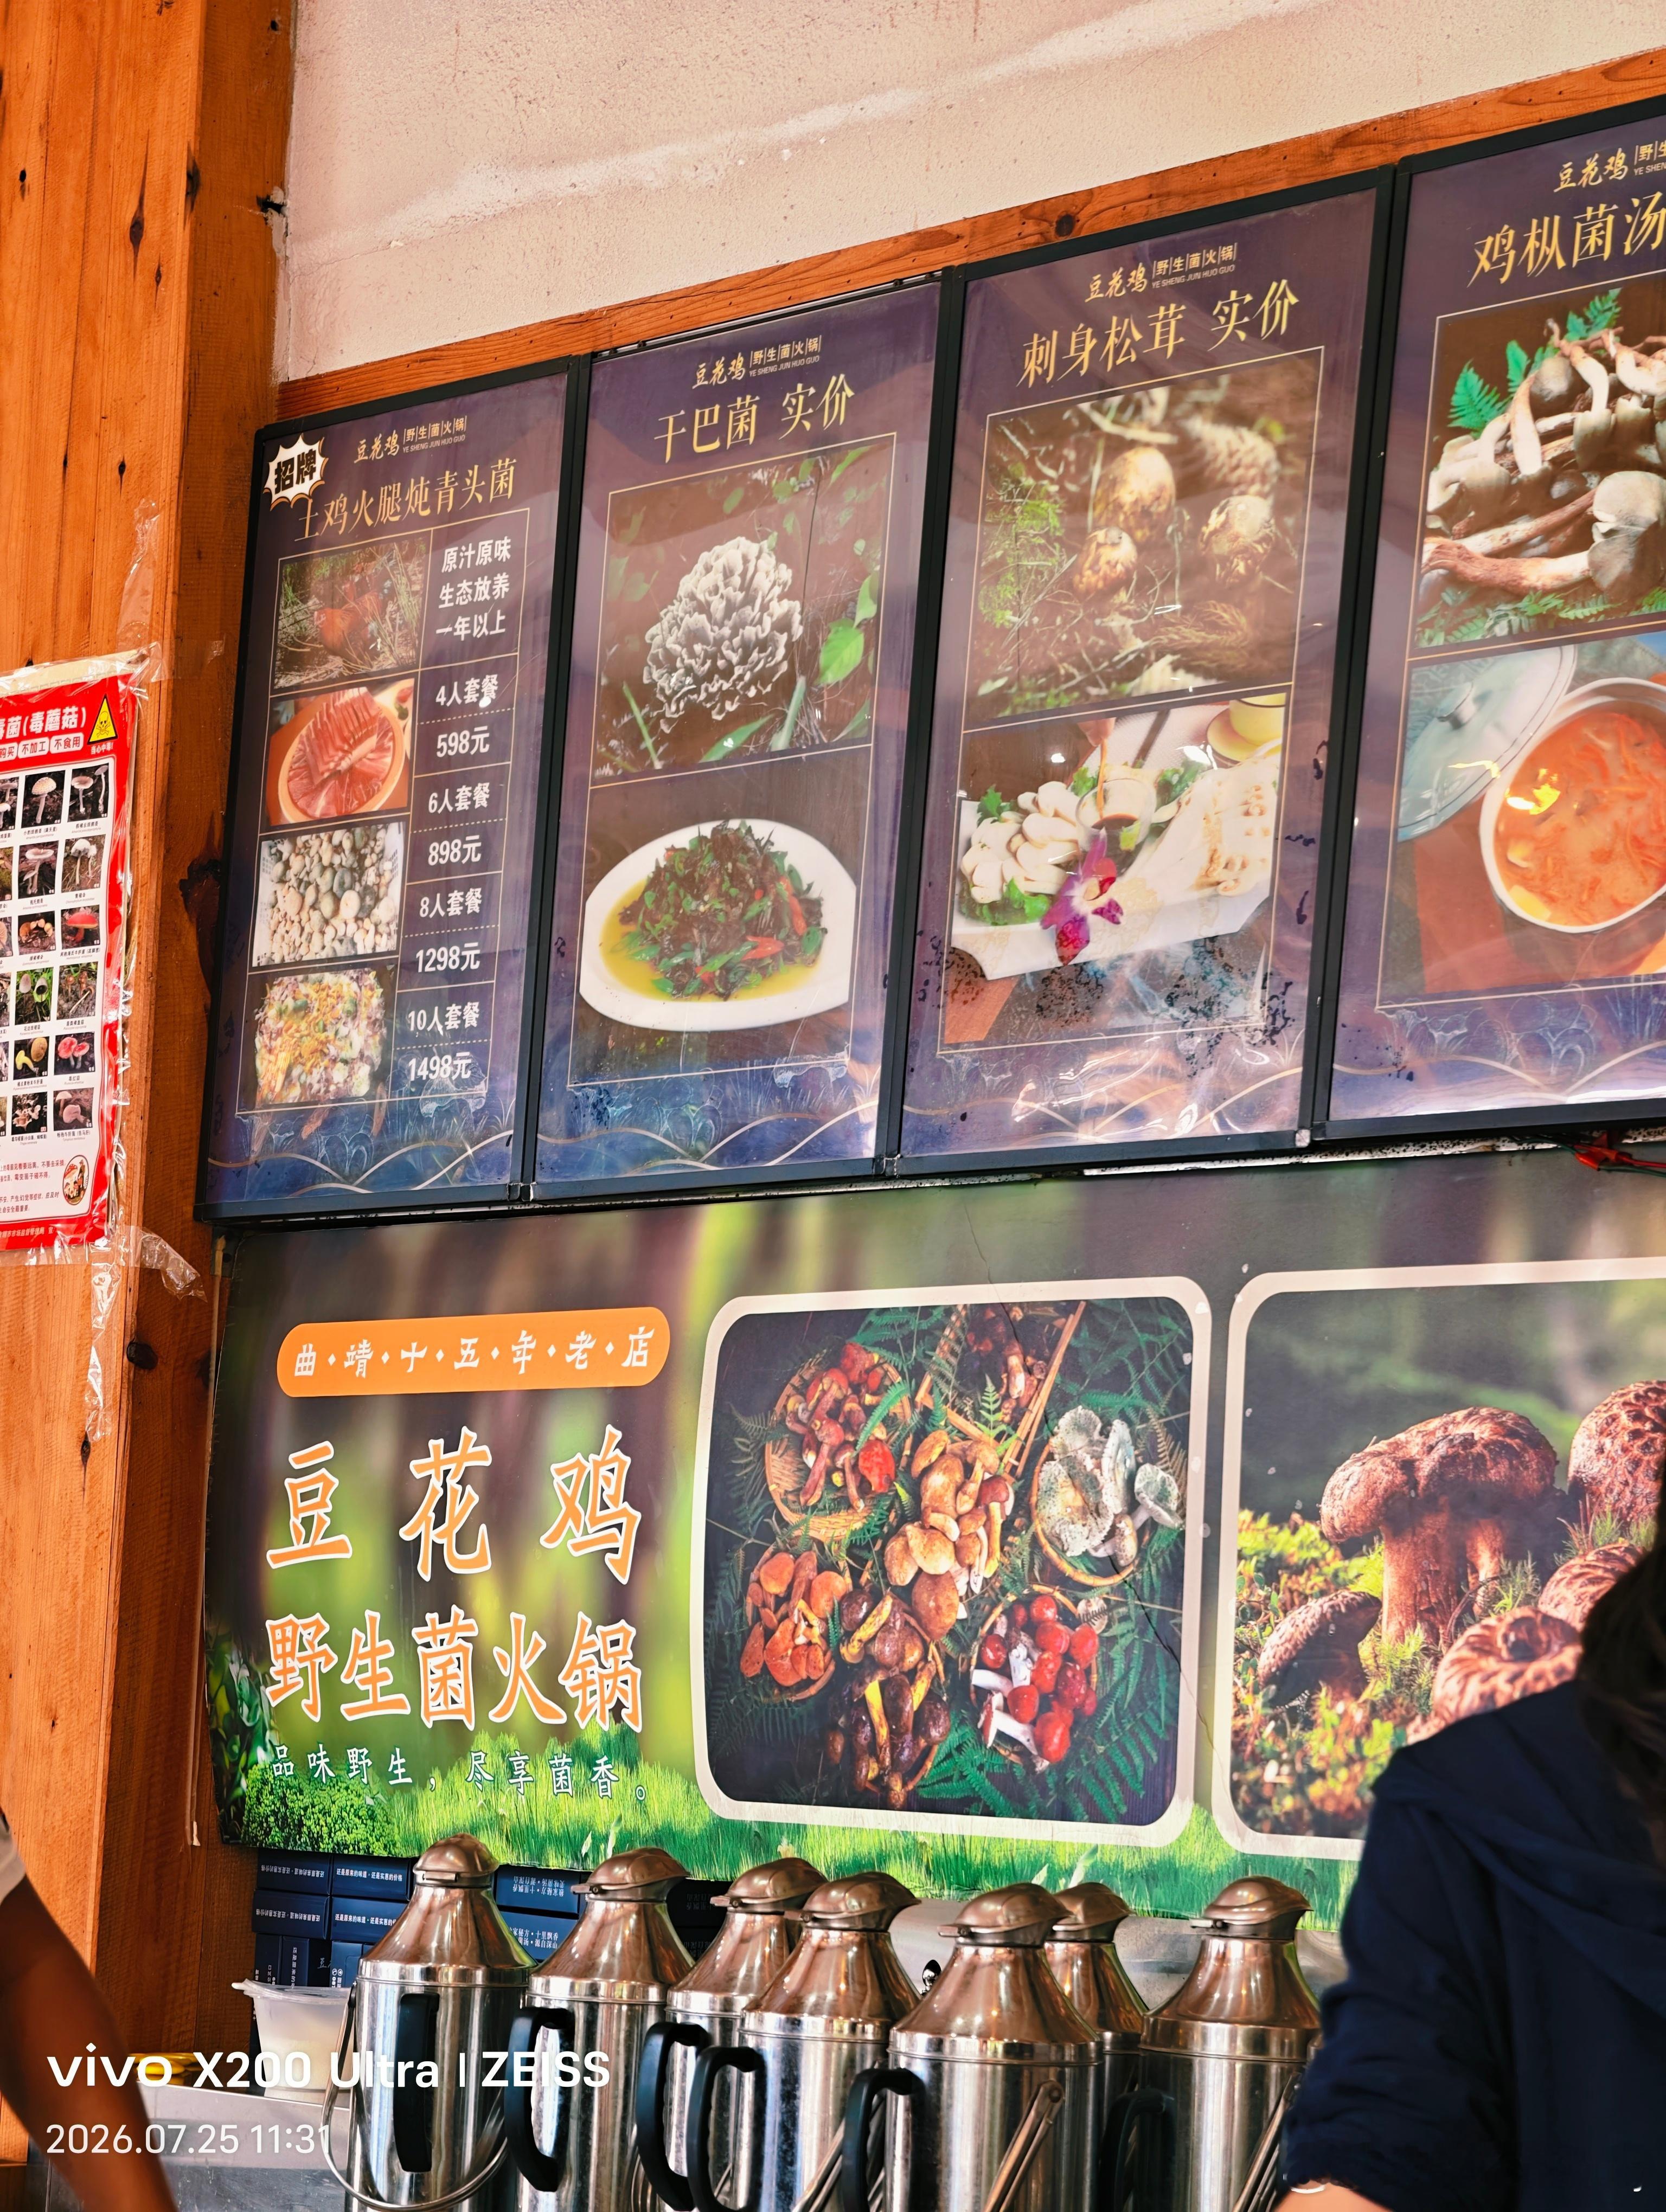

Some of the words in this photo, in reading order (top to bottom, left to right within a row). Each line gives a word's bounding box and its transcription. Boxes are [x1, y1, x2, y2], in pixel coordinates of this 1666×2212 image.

[1554, 147, 1628, 192] 豆花鸡
[1633, 166, 1644, 176] YE
[1466, 191, 1666, 288] 鸡枞菌汤
[1156, 245, 1234, 275] 野生菌火锅
[1085, 263, 1147, 303] 豆花鸡
[1151, 280, 1159, 289] YE
[1161, 276, 1186, 287] SHENG
[1186, 272, 1201, 284] JUN
[1202, 268, 1218, 279] HUO
[1219, 265, 1235, 275] GUO
[1016, 303, 1187, 388] 刺身松茸
[1207, 279, 1300, 352] 实价
[749, 368, 757, 377] YE
[757, 365, 777, 376] SHENG
[778, 361, 791, 371] JUN
[791, 358, 805, 369] HUO
[806, 355, 820, 366] GUO
[753, 337, 819, 365] 野生菌火锅
[692, 352, 746, 389] 豆花鸡
[405, 417, 466, 443] 野生菌火锅
[654, 395, 760, 464] 干巴菌
[778, 374, 855, 440] 实价
[354, 429, 400, 464] 豆花鸡
[409, 442, 428, 452] SHENG
[428, 440, 440, 449] JUN
[441, 437, 453, 446] HUO
[453, 434, 466, 443] GUO
[274, 449, 317, 496] 招牌
[294, 458, 518, 542] 土鸡火腿炖青头菌
[442, 536, 511, 573] 原汁原味
[438, 573, 510, 608] 生态放养
[436, 611, 506, 642] 一年以上
[435, 674, 498, 706] 4人套餐
[22, 740, 46, 755] 不加工
[54, 736, 80, 750] 不食用
[437, 726, 490, 757] 598元
[428, 782, 490, 814] 6人套餐
[428, 835, 482, 866] 898元
[419, 888, 482, 918] 8人套餐
[416, 942, 480, 973] 1298元
[408, 1002, 480, 1032] 10人套餐
[408, 1052, 472, 1082] 1498元
[266, 1424, 642, 1585] 豆花鸡
[266, 1605, 642, 1733] 野生菌火锅
[272, 1744, 646, 1801] 品味野生，尽享菌香。
[510, 1927, 559, 1941] 家秘方·十里飘香
